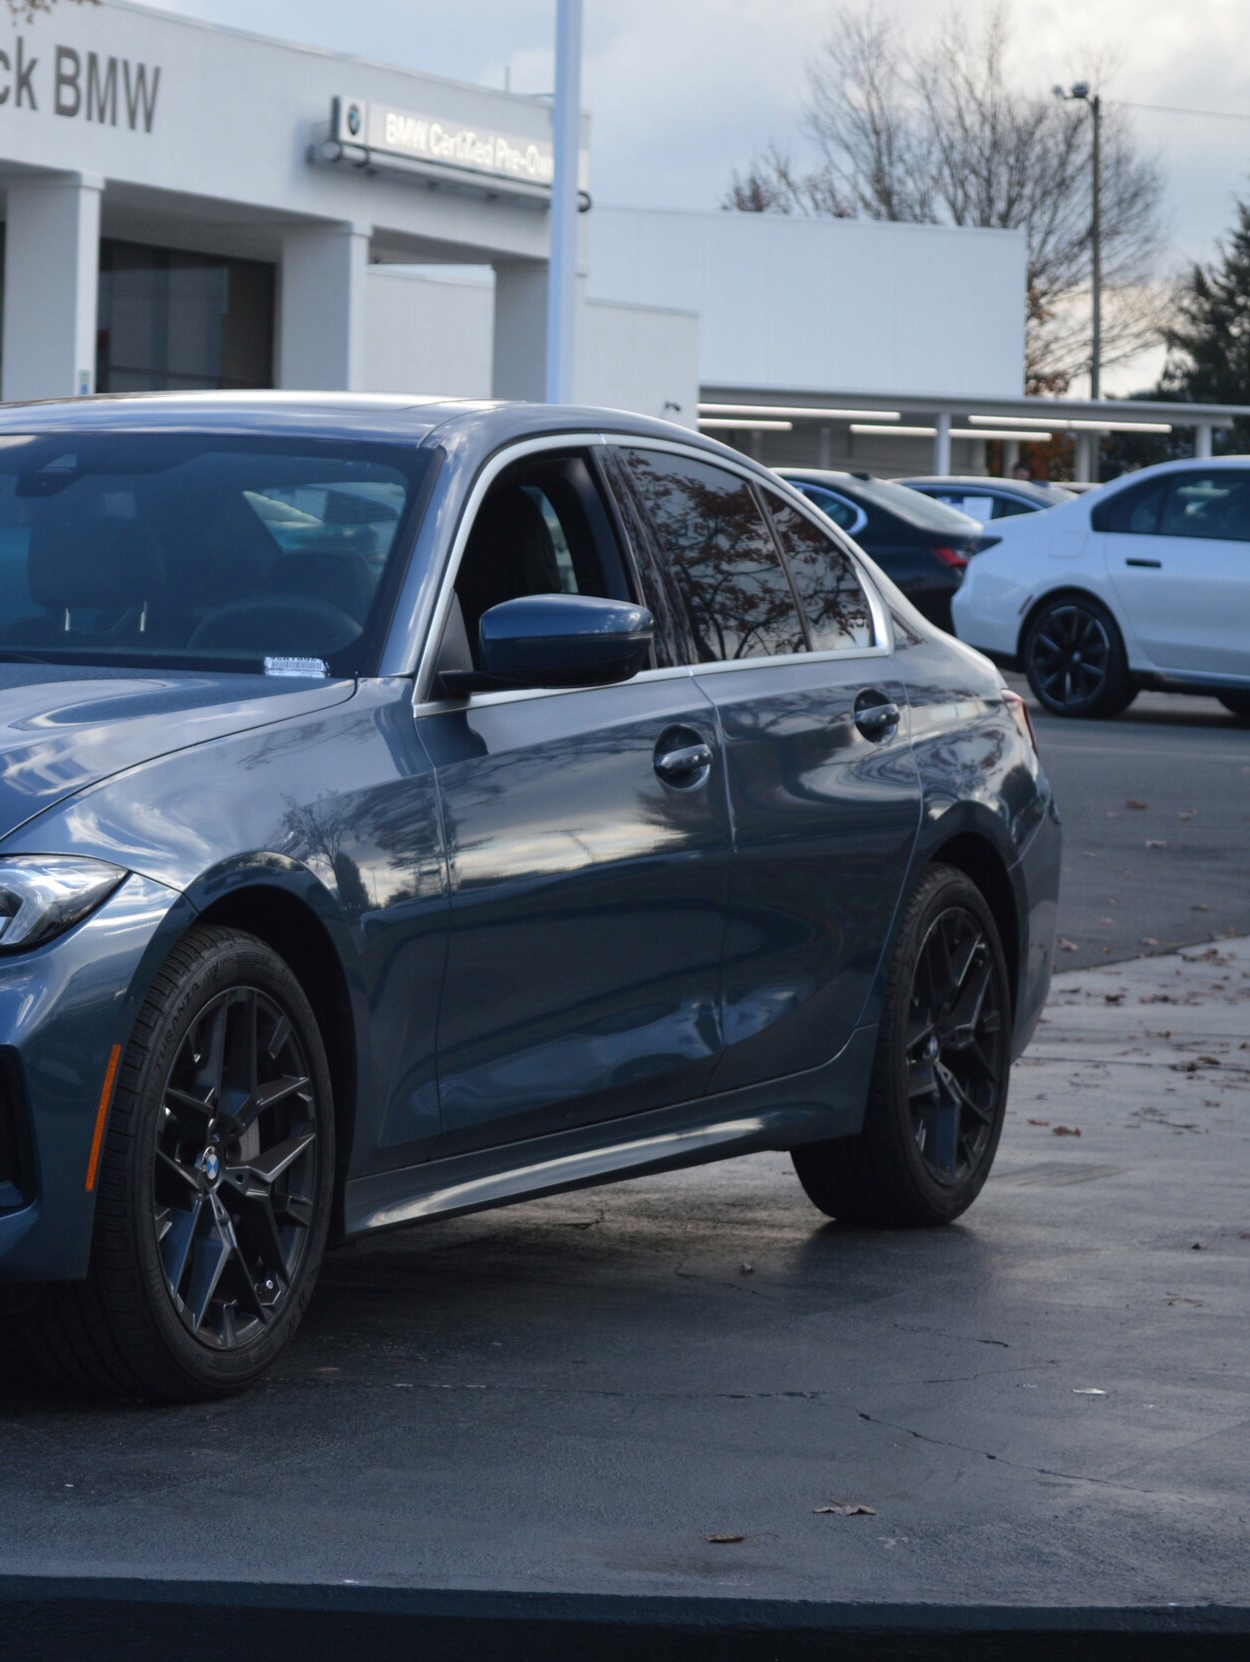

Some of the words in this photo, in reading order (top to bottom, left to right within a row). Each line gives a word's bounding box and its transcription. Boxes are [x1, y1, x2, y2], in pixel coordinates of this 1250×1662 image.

[54, 44, 161, 134] BMW
[385, 112, 429, 152] BMW
[429, 122, 494, 166] Certified
[153, 981, 200, 1071] TURANZA
